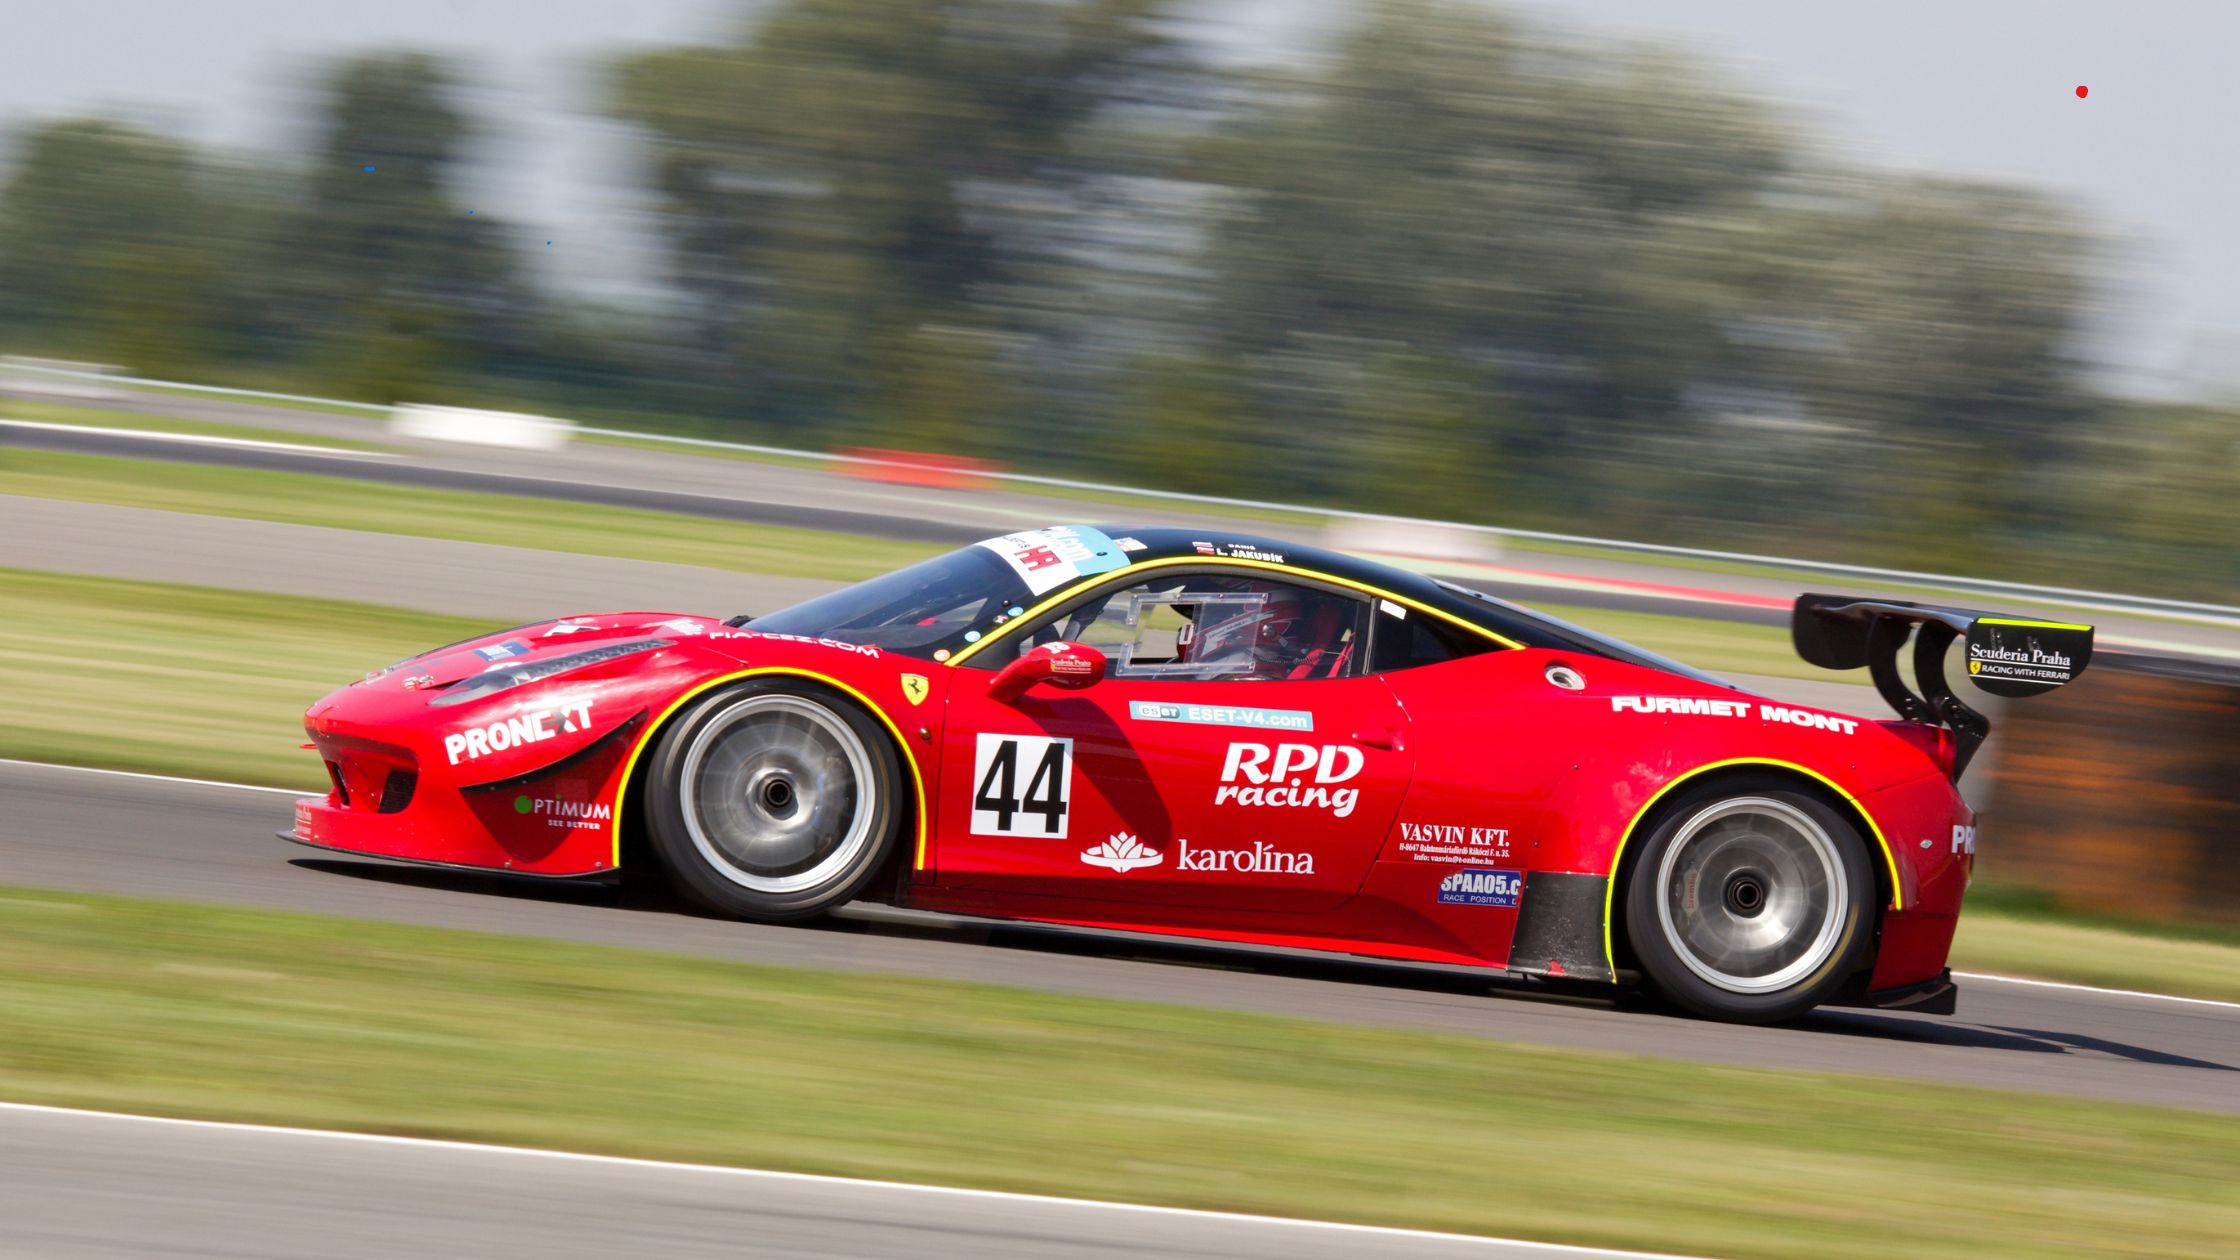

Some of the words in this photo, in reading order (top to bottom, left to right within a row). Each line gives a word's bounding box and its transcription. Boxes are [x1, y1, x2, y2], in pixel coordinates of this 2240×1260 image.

[1216, 548, 1228, 556] L.
[1231, 549, 1285, 563] JAKUBÍK
[709, 632, 880, 658] FIA-CEZ.COM
[1970, 643, 2029, 662] Scuderia
[2032, 649, 2071, 666] Praha
[1982, 665, 2014, 675] RACING
[2014, 668, 2036, 677] WITH
[2037, 670, 2070, 680] FERRARI
[1188, 707, 1308, 728] ESET-V4.com
[1611, 697, 1751, 718] FURMET
[1760, 705, 1859, 735] MONT
[444, 699, 594, 765] PRONEXT
[1220, 742, 1365, 784] RPD
[975, 740, 1067, 833] 44
[1214, 778, 1359, 818] racing
[548, 819, 563, 827] SEE
[567, 821, 600, 830] BETTER
[1400, 823, 1466, 844] VASVIN
[1470, 827, 1510, 847] KFT.
[1952, 824, 1976, 854] PR
[1176, 839, 1315, 874] karolína
[1413, 853, 1430, 861] Info:
[1443, 894, 1465, 902] RACE
[1470, 895, 1506, 905] POSITION
